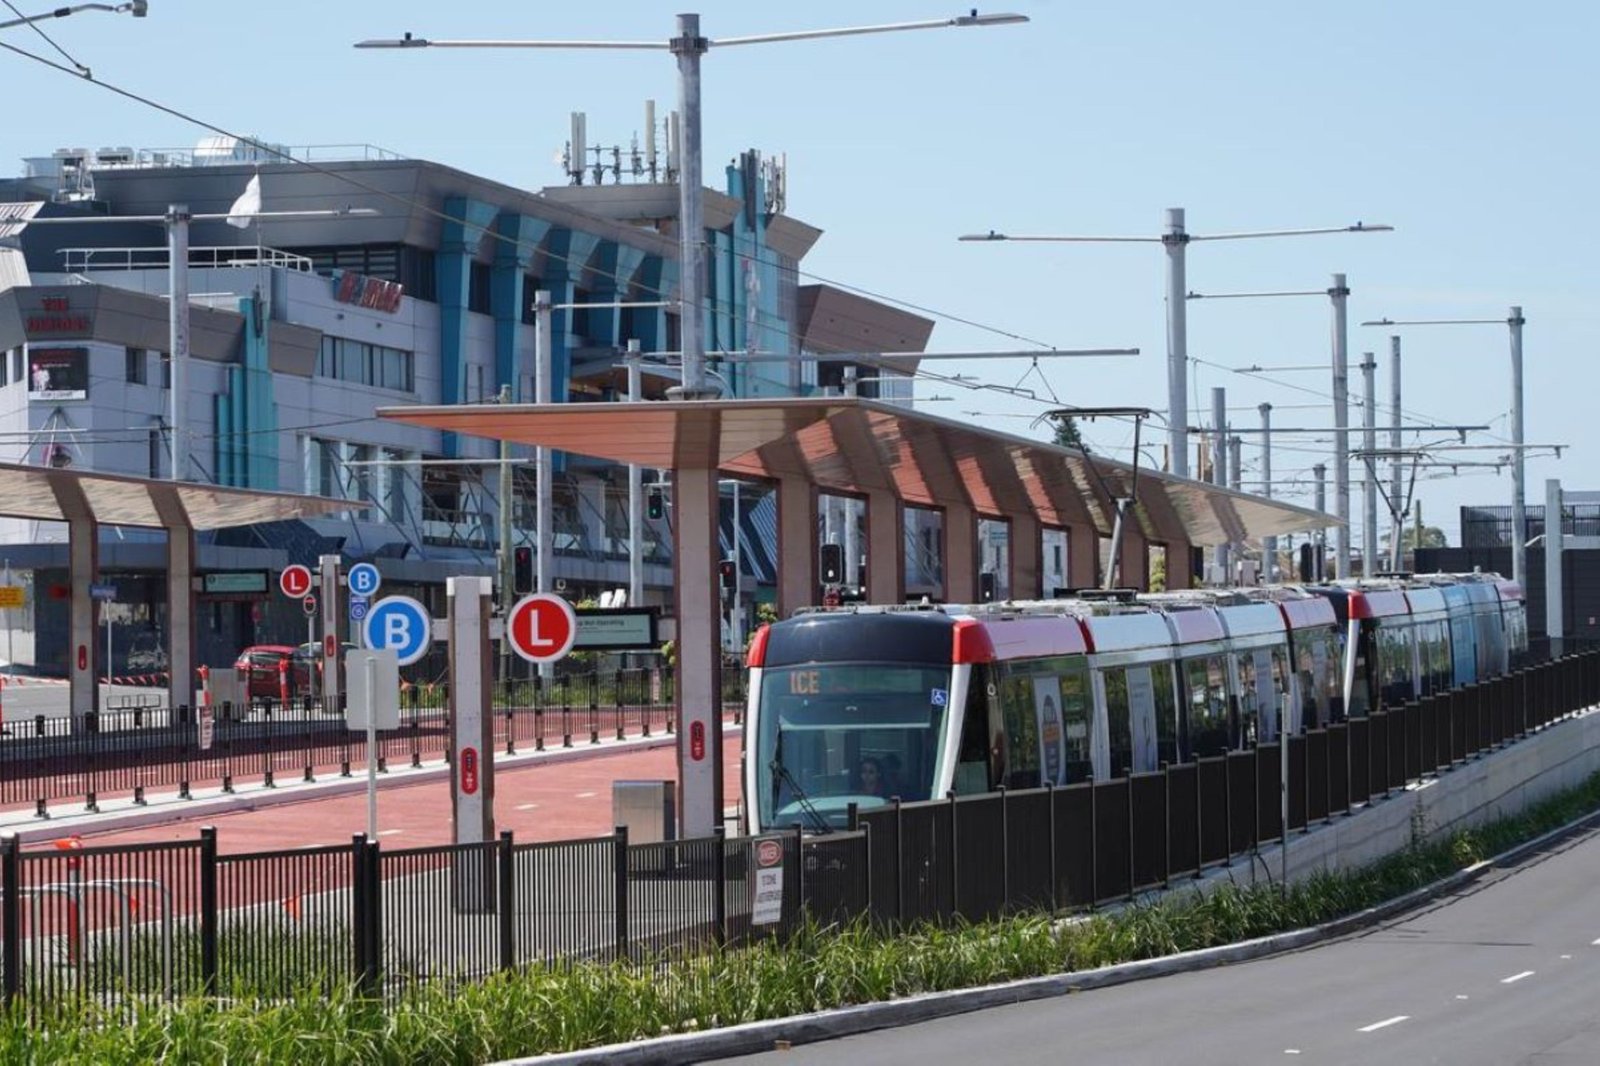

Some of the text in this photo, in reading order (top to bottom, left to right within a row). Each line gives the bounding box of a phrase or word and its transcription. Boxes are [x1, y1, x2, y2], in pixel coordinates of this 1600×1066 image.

[290, 573, 303, 590] L
[357, 572, 370, 590] B
[385, 613, 411, 650] B
[531, 609, 554, 646] L
